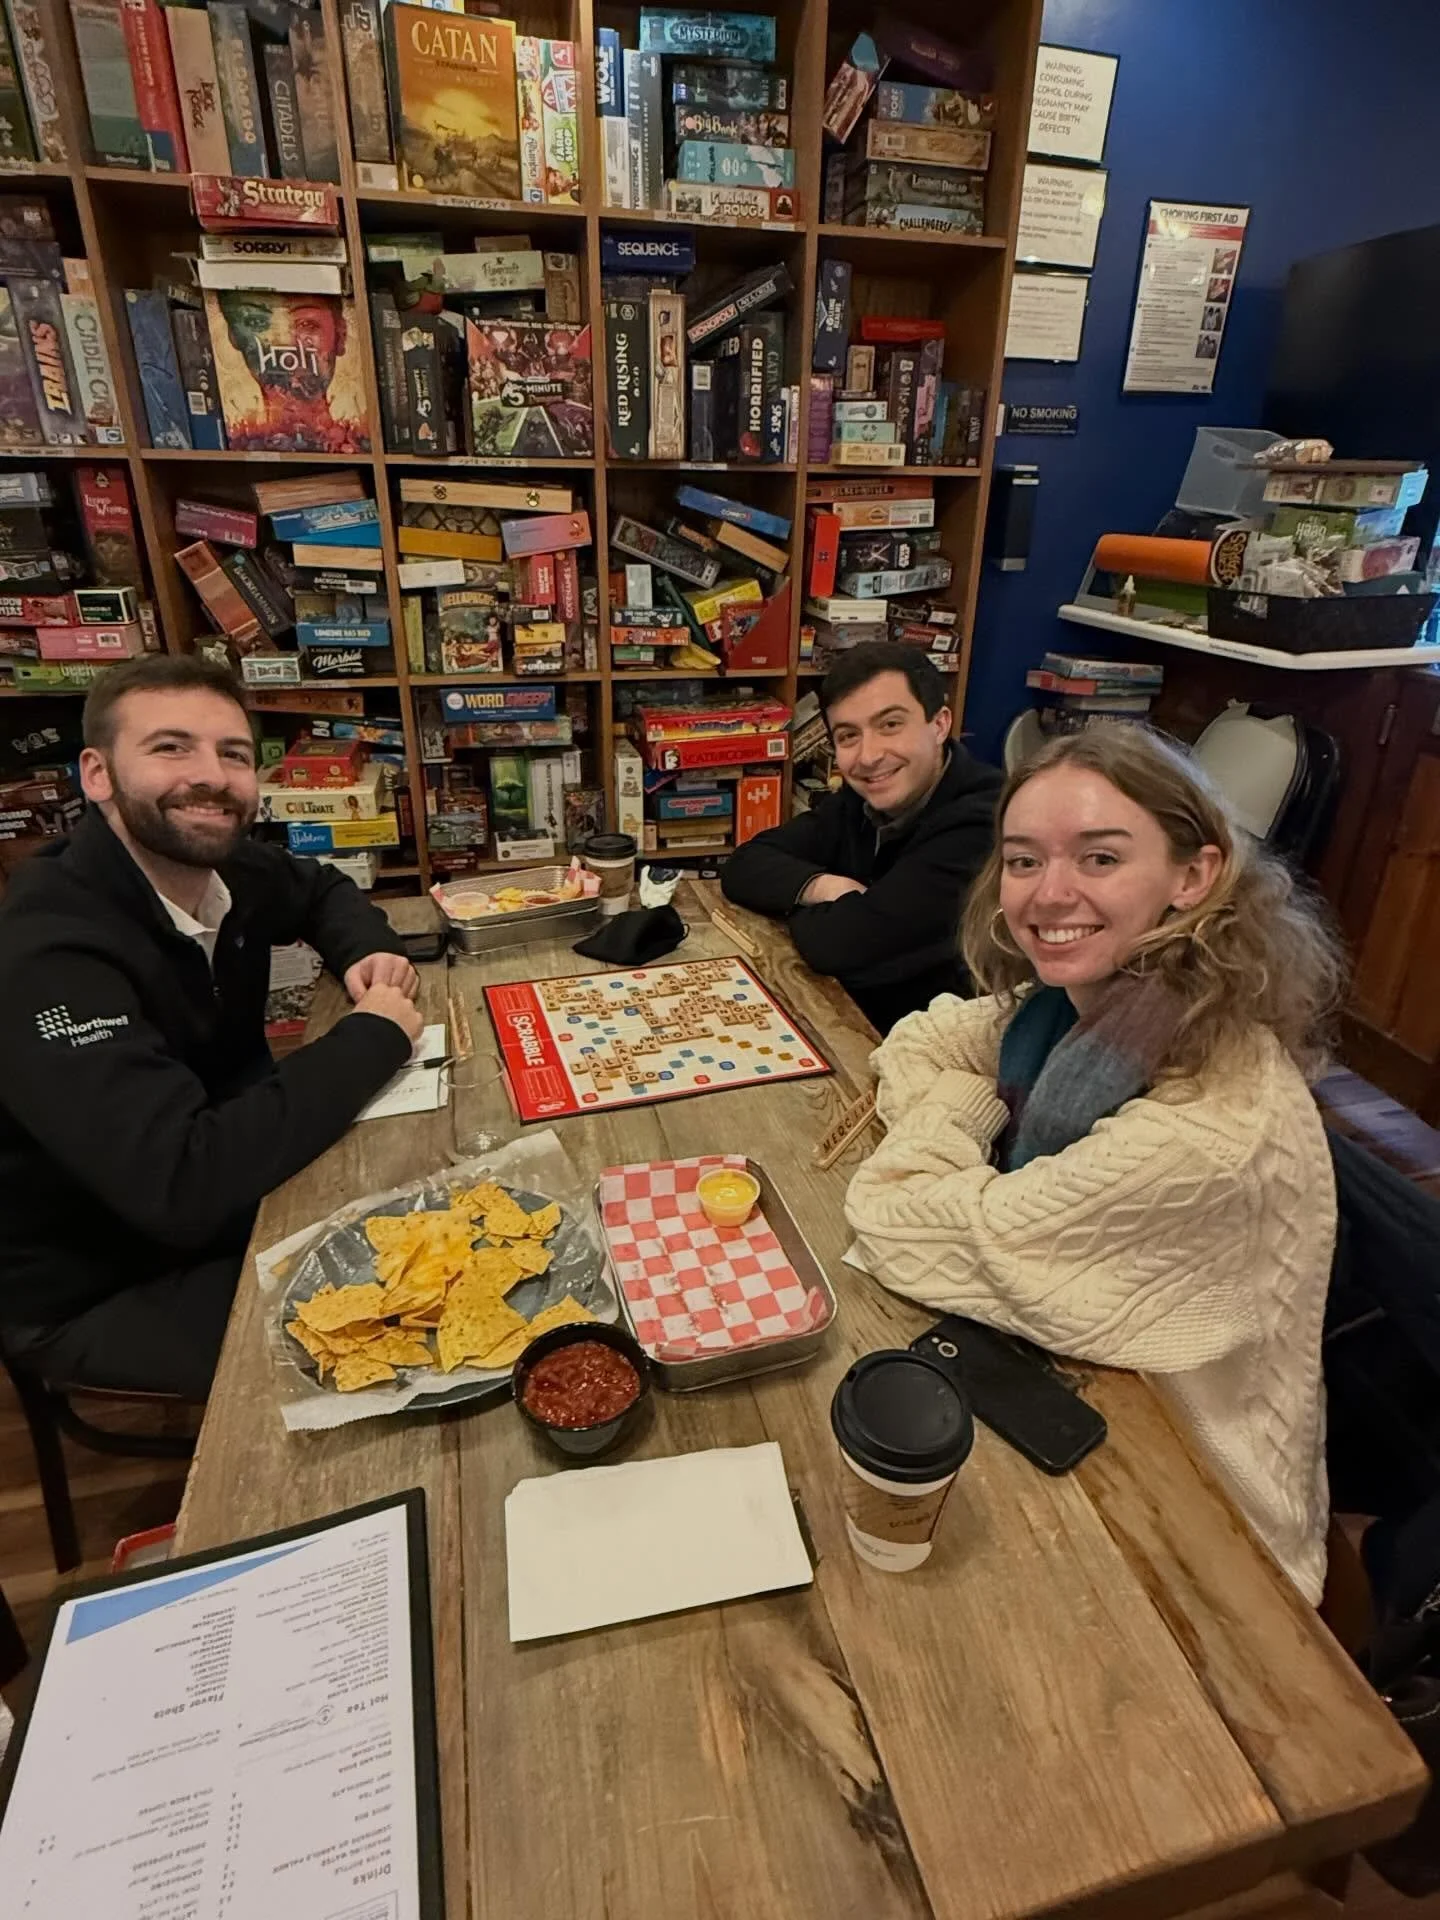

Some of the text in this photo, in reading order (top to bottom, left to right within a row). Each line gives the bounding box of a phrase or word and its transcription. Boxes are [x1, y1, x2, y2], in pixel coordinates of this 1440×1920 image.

[411, 20, 498, 67] CATAN
[678, 25, 741, 43] MYSTERIUM
[274, 80, 298, 161] CITADELS
[1038, 122, 1071, 135] DEFECTS
[242, 180, 325, 208] Stratego
[1200, 211, 1222, 223] FIRST
[1224, 213, 1239, 224] AID
[233, 241, 292, 254] SORRY!
[618, 242, 680, 256] SEQUENCE
[615, 333, 632, 426] RED RISING
[750, 337, 764, 432] HORRIFIED
[1012, 407, 1077, 419] NO SMOKING
[312, 646, 363, 668] Morbid
[464, 693, 505, 708] WORD
[67, 1015, 129, 1036] Northwell
[70, 1028, 114, 1047] Health
[512, 1015, 545, 1066] SCRABBLE
[153, 1692, 224, 1720] Flavor Shots
[346, 1693, 389, 1714] Hot Tea
[352, 1863, 392, 1886] Drinks
